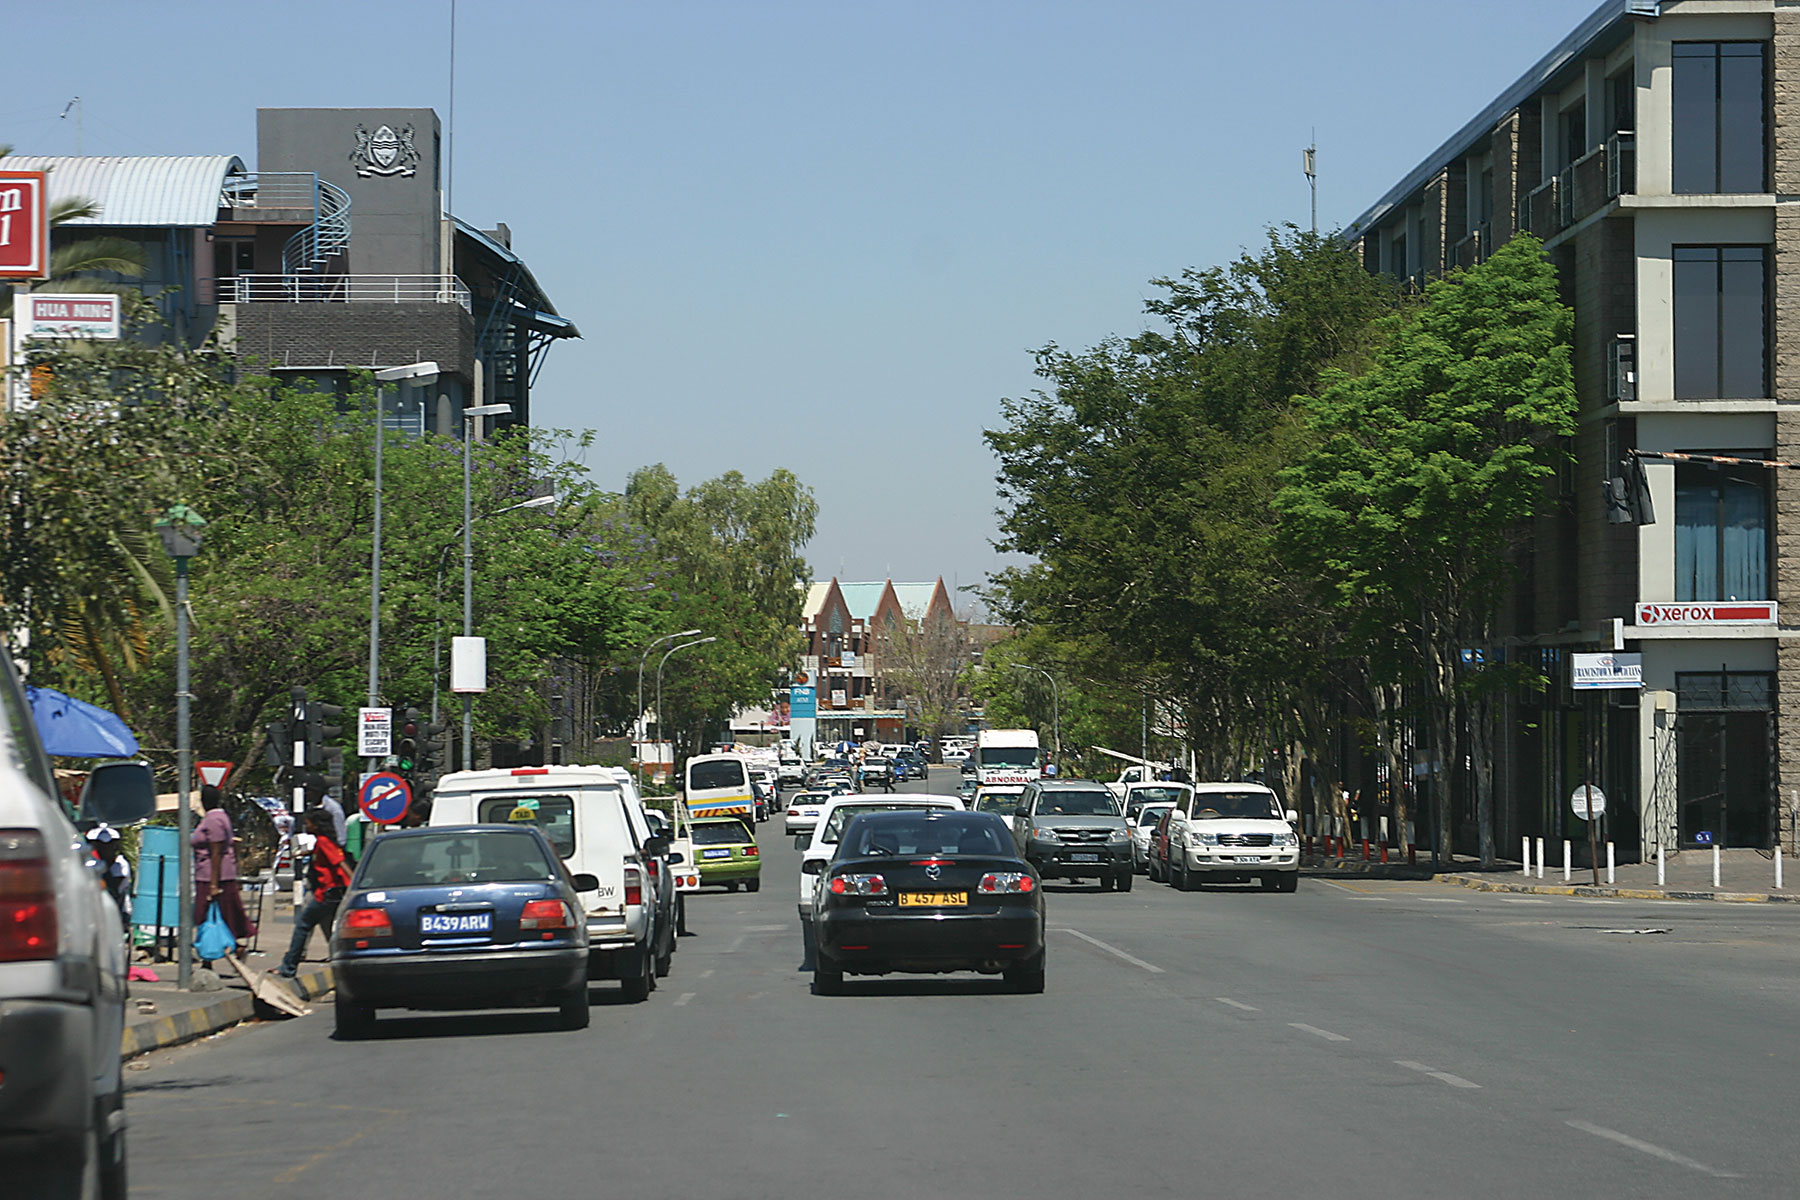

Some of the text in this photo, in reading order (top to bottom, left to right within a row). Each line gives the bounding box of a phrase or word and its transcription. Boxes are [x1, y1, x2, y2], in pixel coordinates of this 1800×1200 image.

[36, 303, 111, 318] HUA NING
[1661, 607, 1713, 621] xerox
[598, 886, 615, 897] BW
[901, 893, 908, 905] B
[915, 893, 936, 904] 457
[942, 892, 966, 904] ASL
[422, 915, 490, 931] B439ARW
